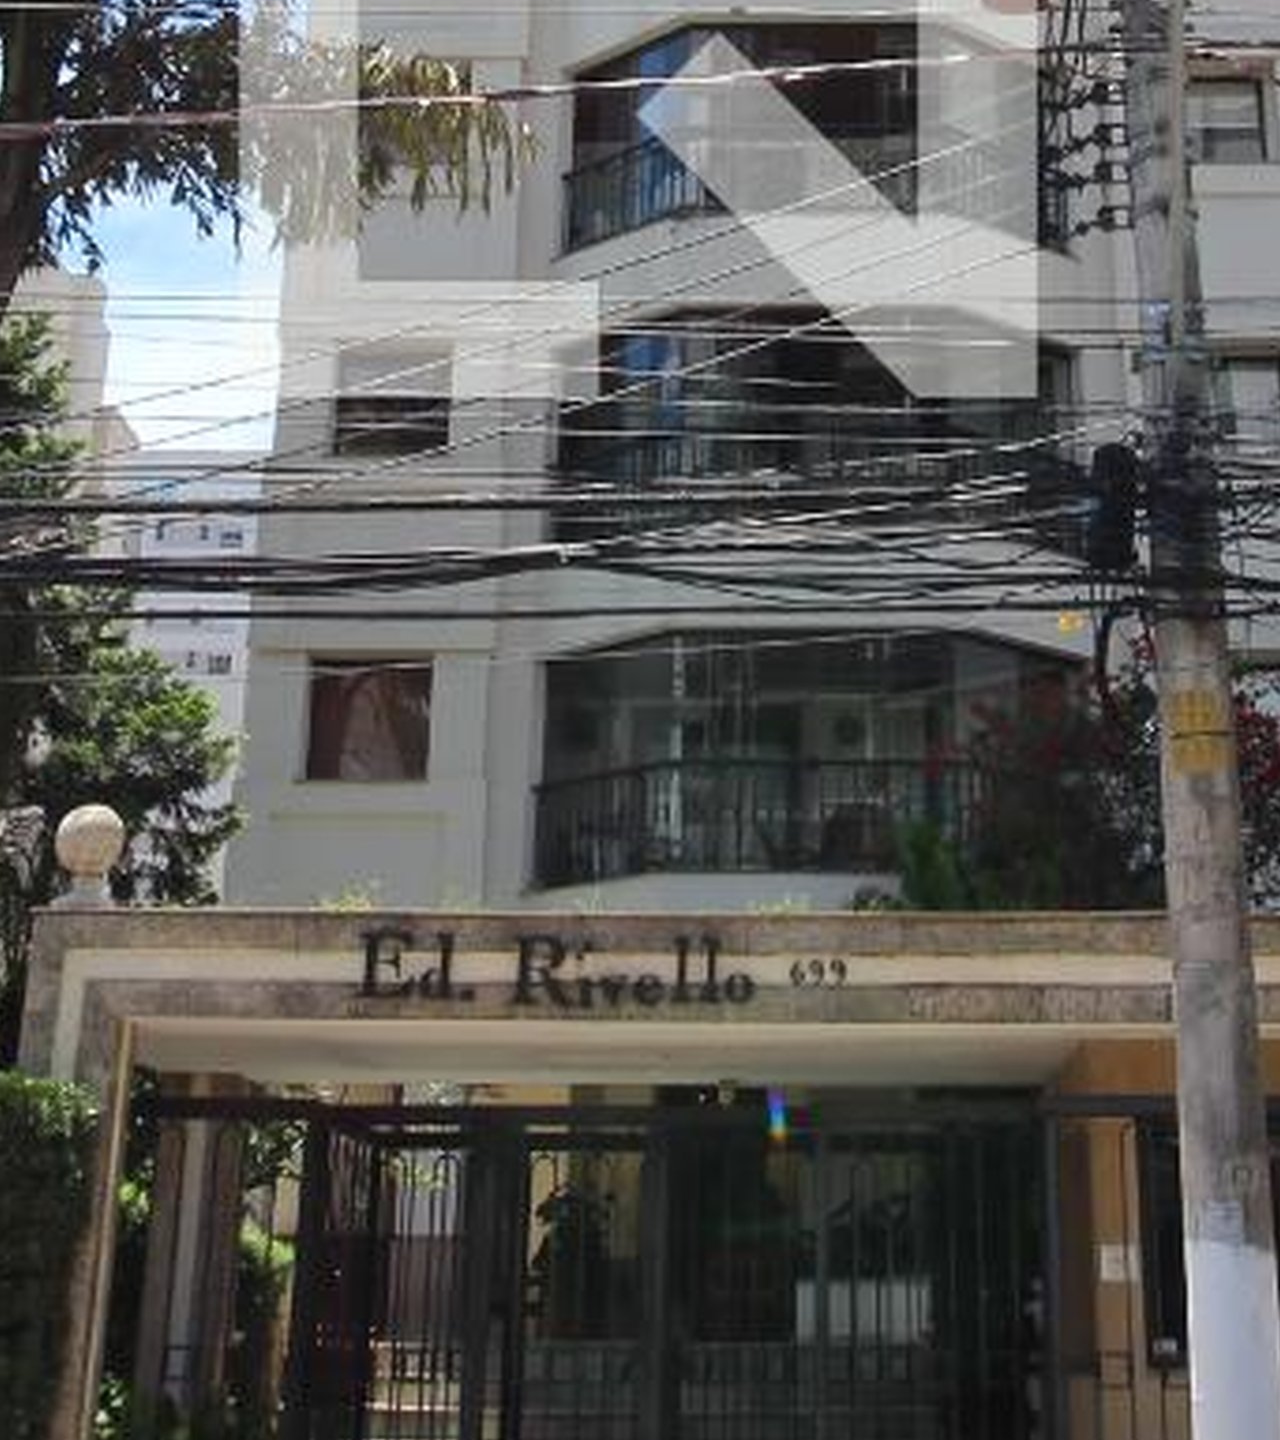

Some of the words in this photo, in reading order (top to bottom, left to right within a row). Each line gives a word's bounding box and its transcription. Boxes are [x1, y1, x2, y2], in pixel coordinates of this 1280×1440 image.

[357, 929, 475, 1001] Ed.
[514, 933, 756, 1007] Rivello
[789, 958, 848, 991] 699
